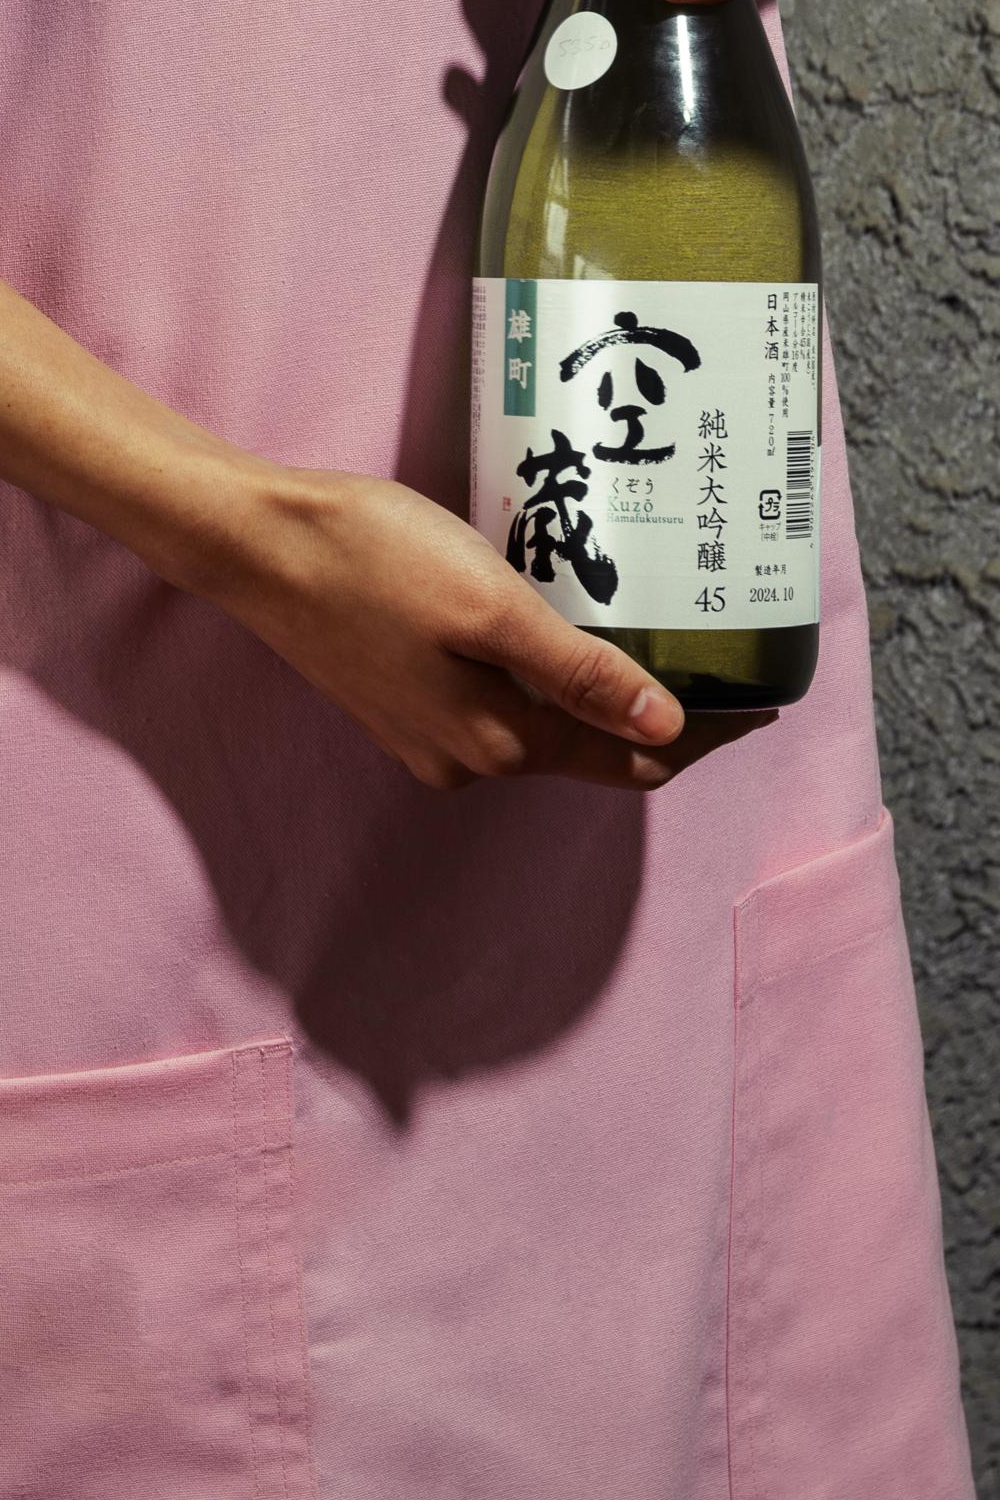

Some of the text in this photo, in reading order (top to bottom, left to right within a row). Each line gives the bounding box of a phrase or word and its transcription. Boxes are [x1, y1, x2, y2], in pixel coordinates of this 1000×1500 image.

[765, 294, 780, 362] 日本酒
[507, 308, 533, 390] 雄町
[611, 476, 655, 495] くぞう
[696, 408, 728, 574] 純米大吟醸
[607, 495, 654, 513] Kuzō
[606, 512, 685, 524] Hamafukutsuru
[755, 563, 786, 576] 製造年月
[694, 586, 727, 614] 45
[749, 586, 794, 603] 2024.10
